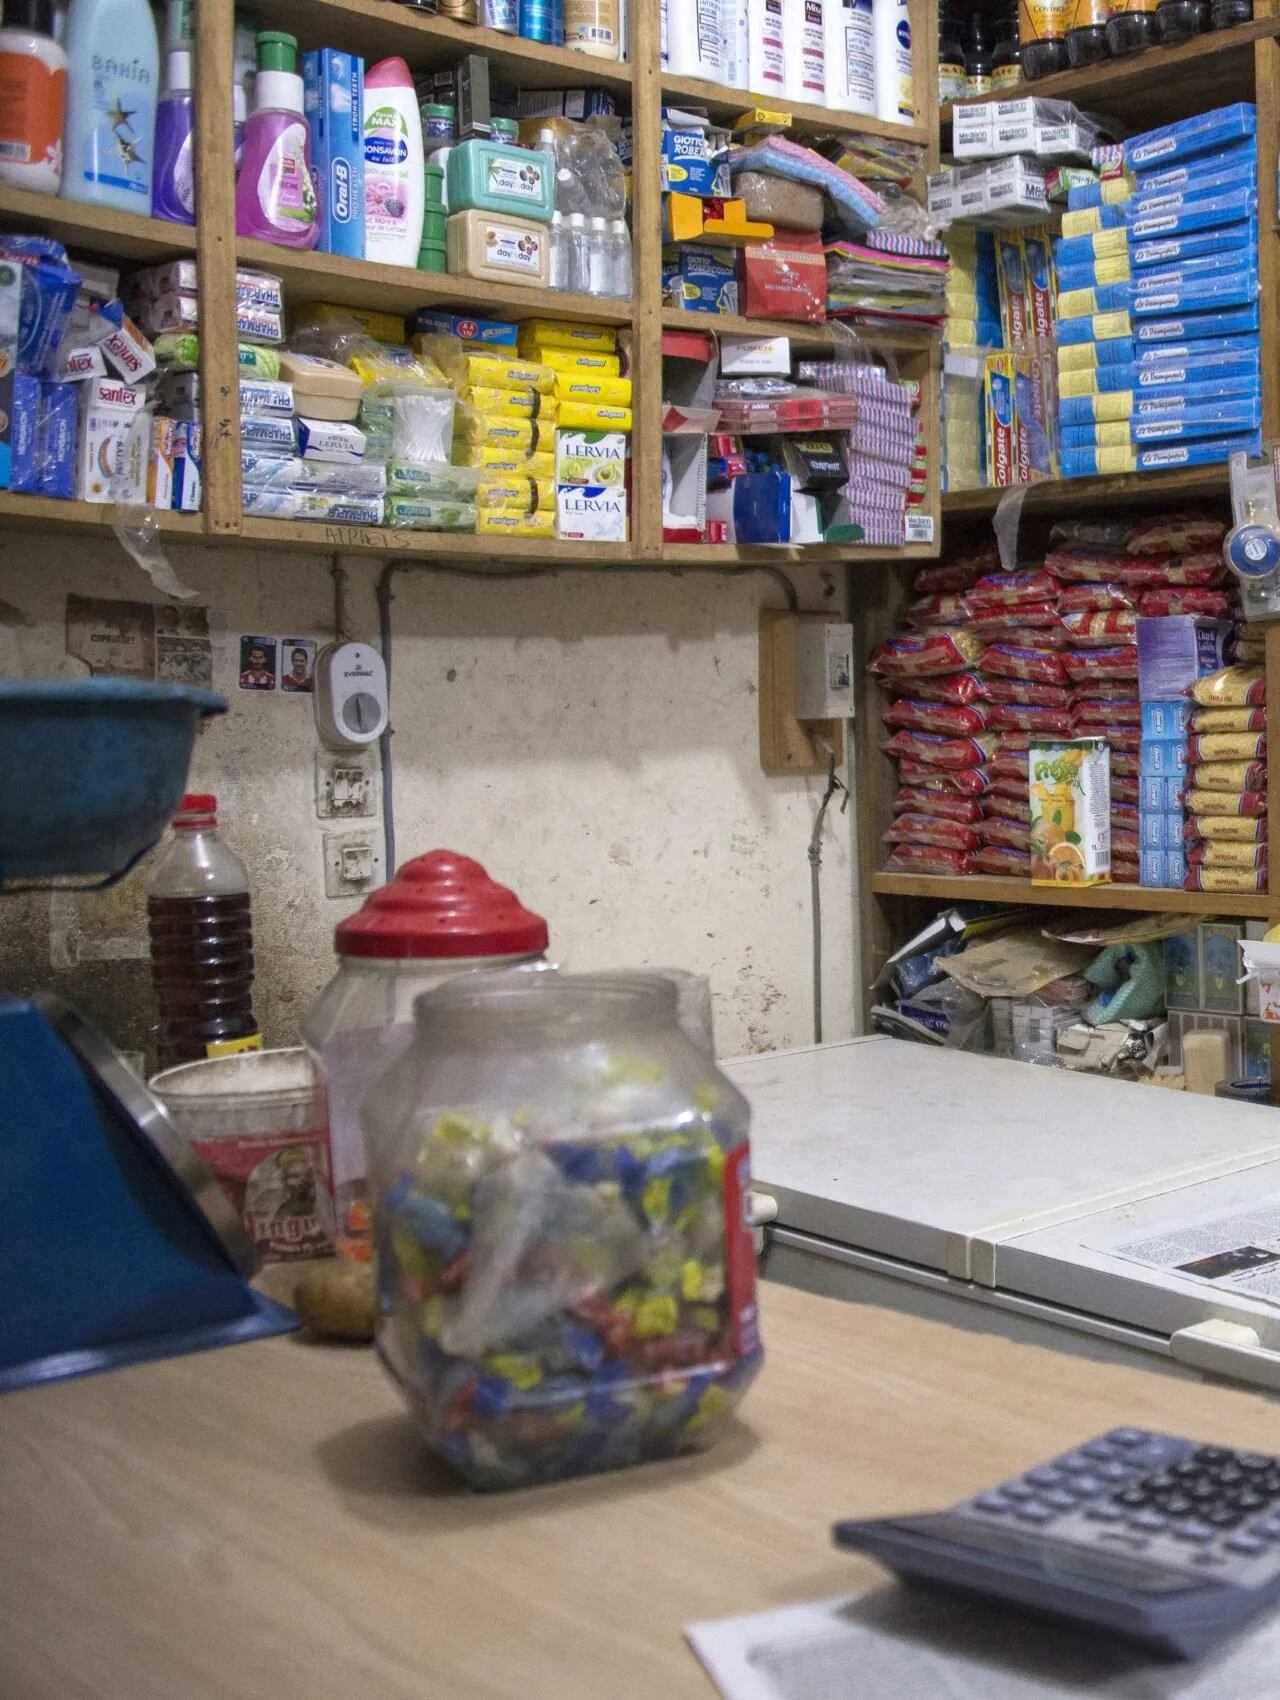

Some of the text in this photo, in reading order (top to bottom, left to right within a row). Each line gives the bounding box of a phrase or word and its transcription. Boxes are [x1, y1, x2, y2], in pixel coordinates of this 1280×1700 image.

[336, 165, 350, 218] Oral-B
[576, 358, 606, 367] Safeguard
[99, 386, 137, 405] santex
[565, 444, 620, 459] LERVIA
[564, 499, 621, 512] LERVIA
[328, 507, 379, 524] PHARMAPUR
